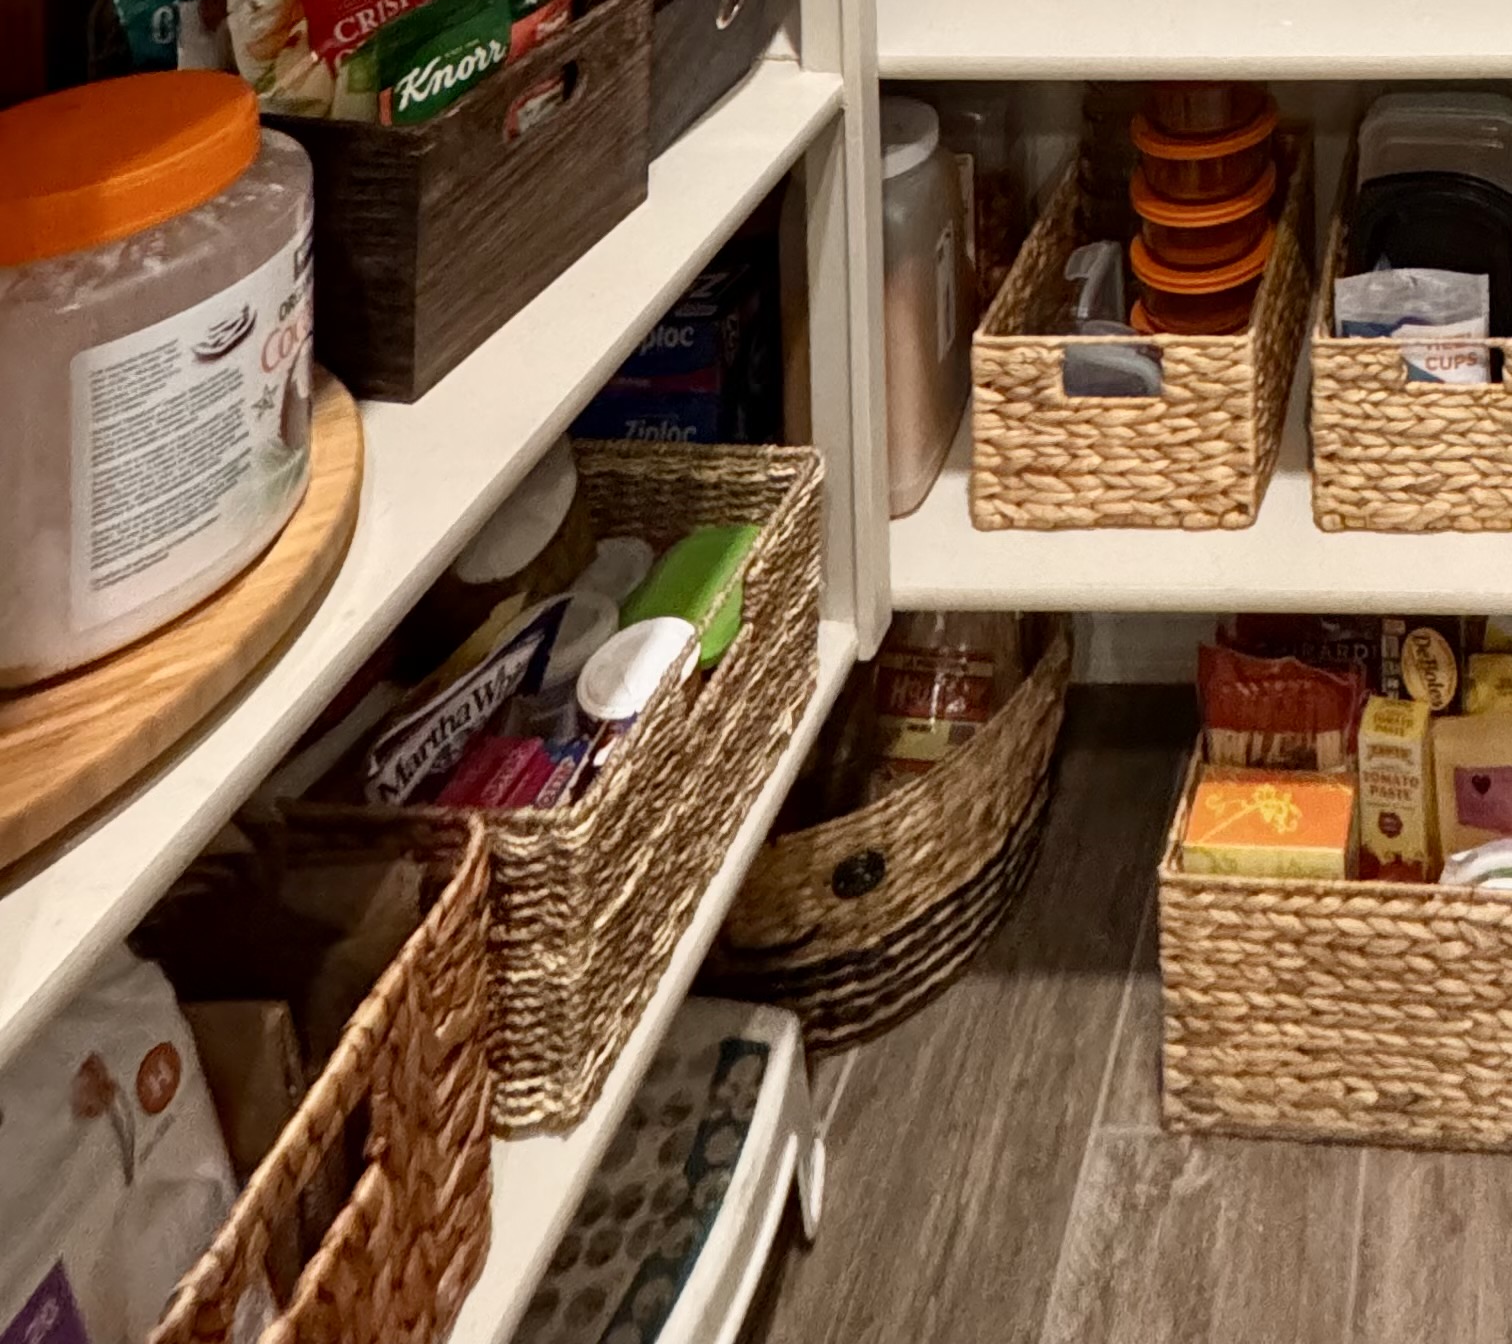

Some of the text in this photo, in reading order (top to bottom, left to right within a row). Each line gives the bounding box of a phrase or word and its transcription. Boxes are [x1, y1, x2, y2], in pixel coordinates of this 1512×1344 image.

[394, 39, 507, 112] Knorr
[638, 325, 695, 356] ploc
[1425, 352, 1478, 371] CUPS
[1363, 770, 1420, 786] TOMATO
